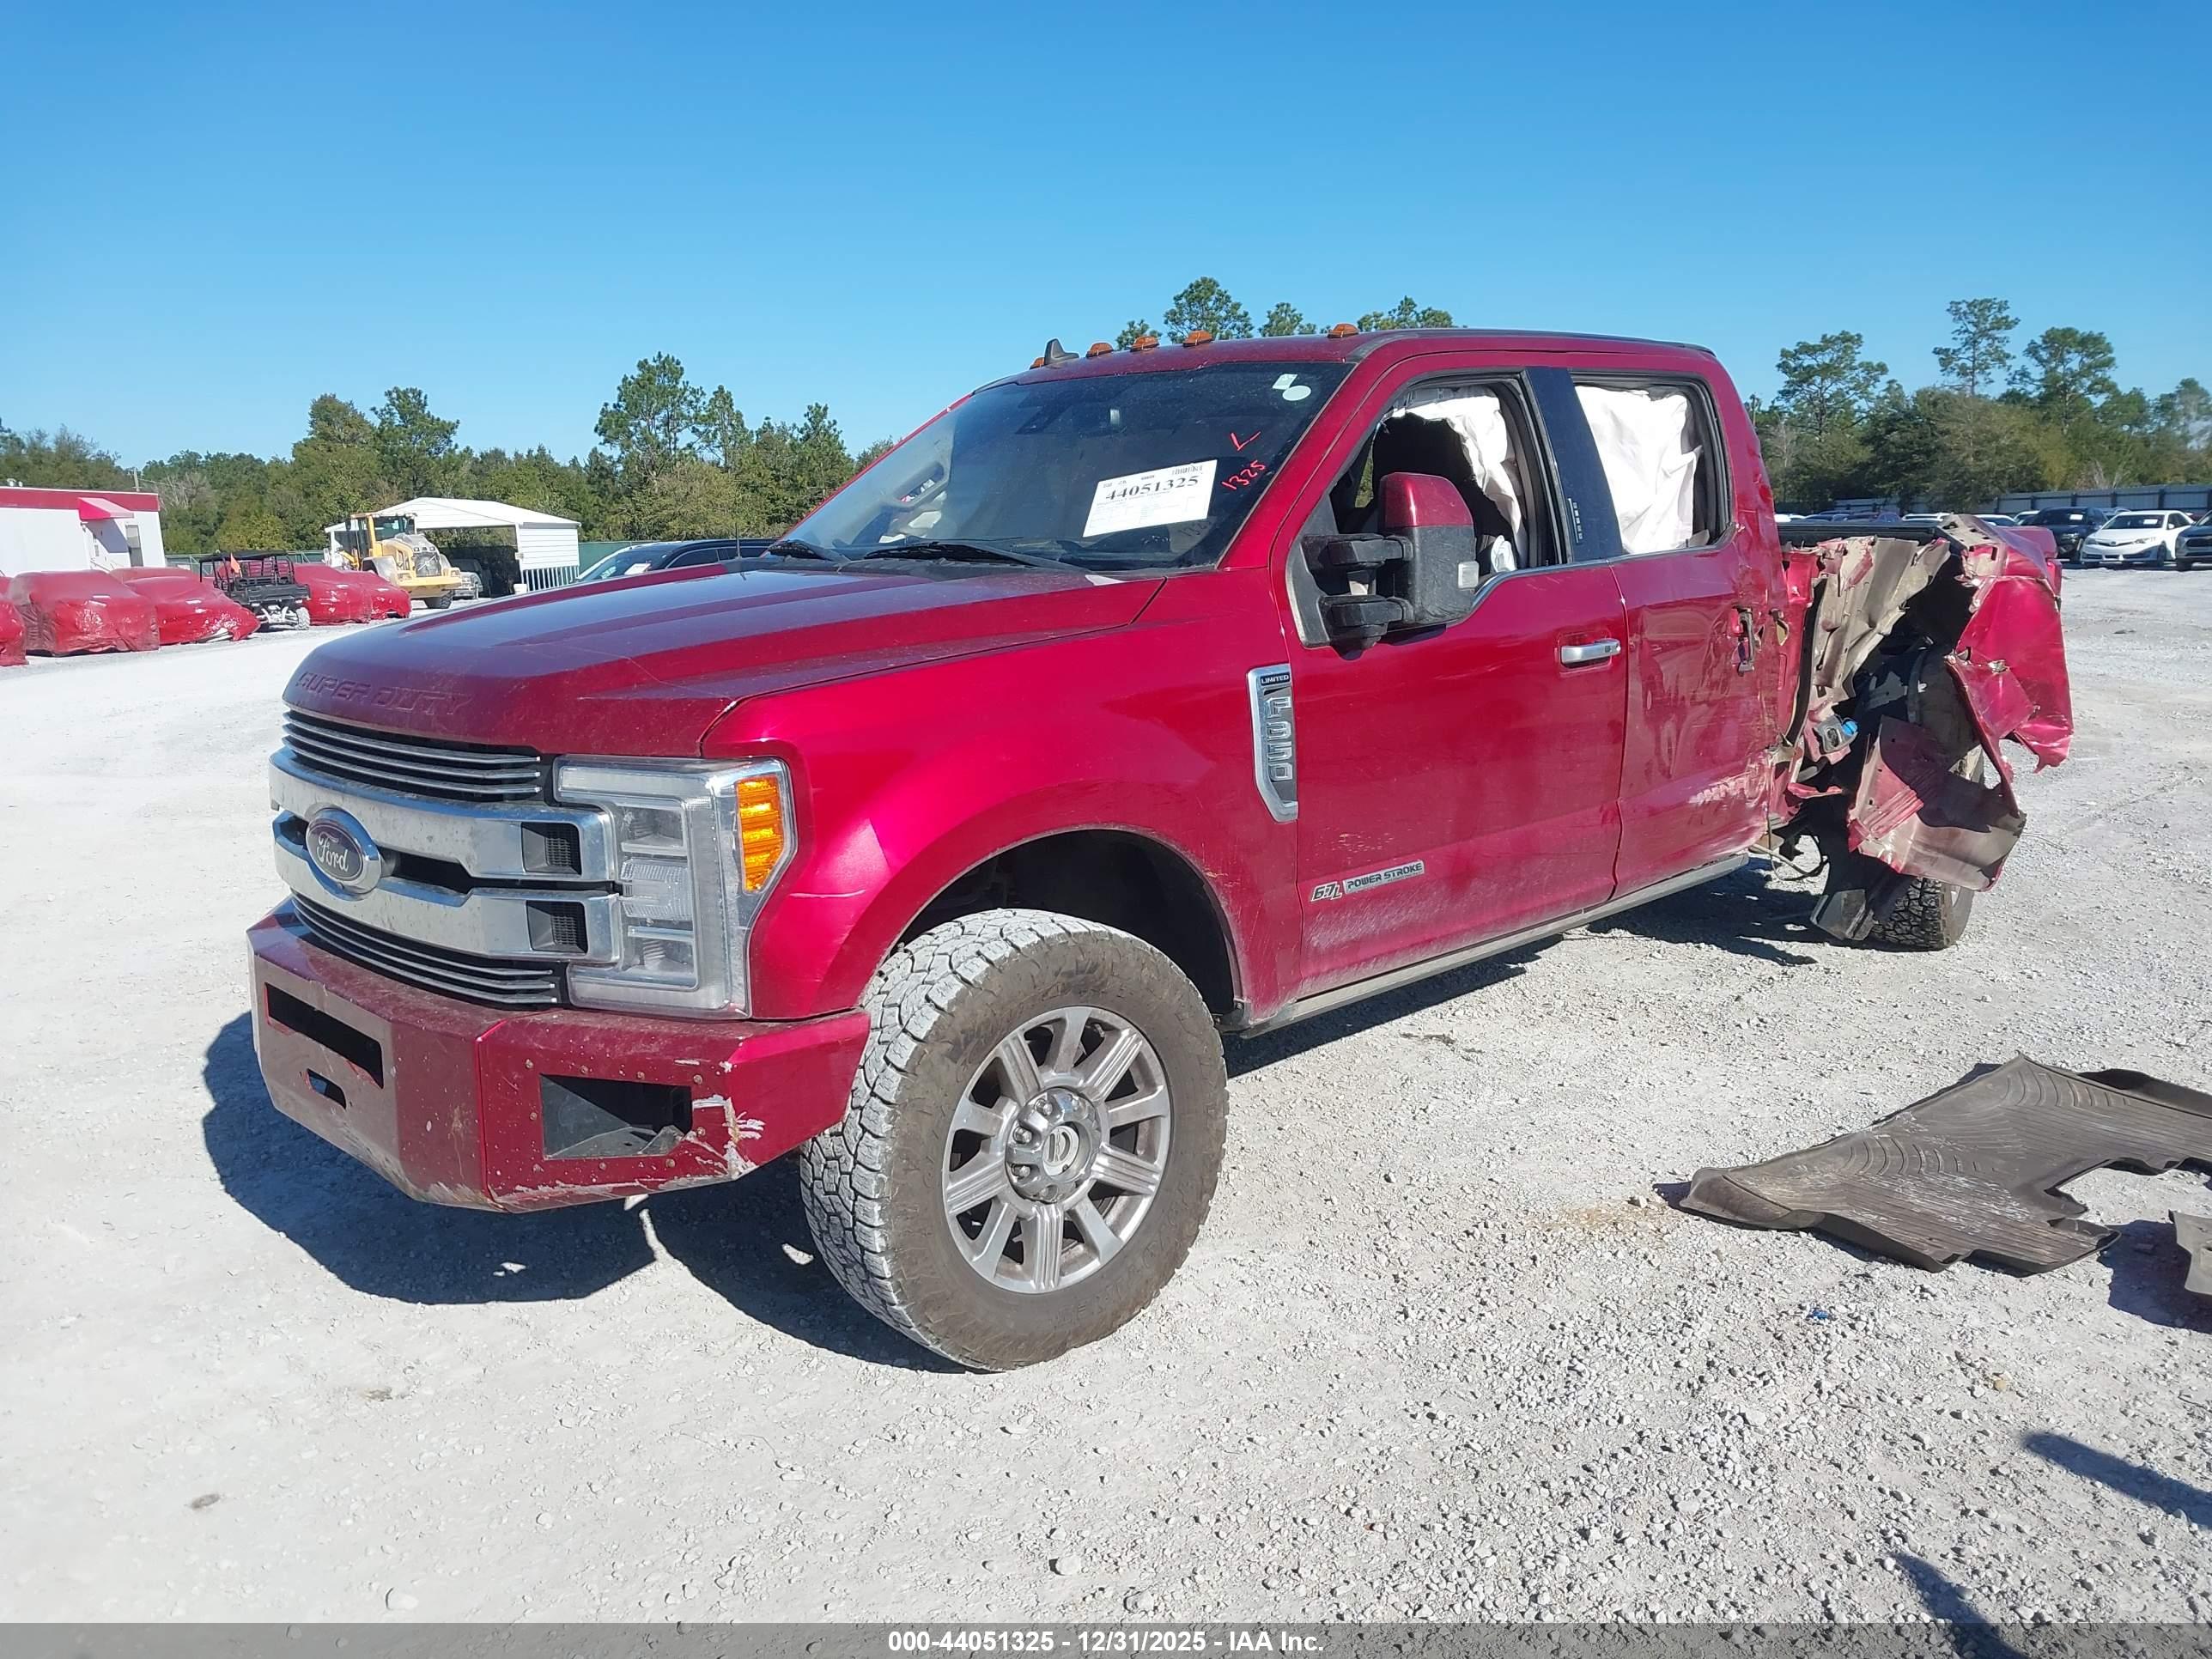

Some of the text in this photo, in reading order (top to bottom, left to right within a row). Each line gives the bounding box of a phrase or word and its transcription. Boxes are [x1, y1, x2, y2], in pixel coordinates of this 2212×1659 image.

[1105, 475, 1199, 500] 44051325
[1221, 459, 1266, 490] 1325
[1261, 674, 1290, 684] LIMITED
[372, 686, 473, 714] DUTY
[316, 831, 349, 872] Ford
[1346, 873, 1382, 890] POWER
[1383, 862, 1423, 880] STROKE
